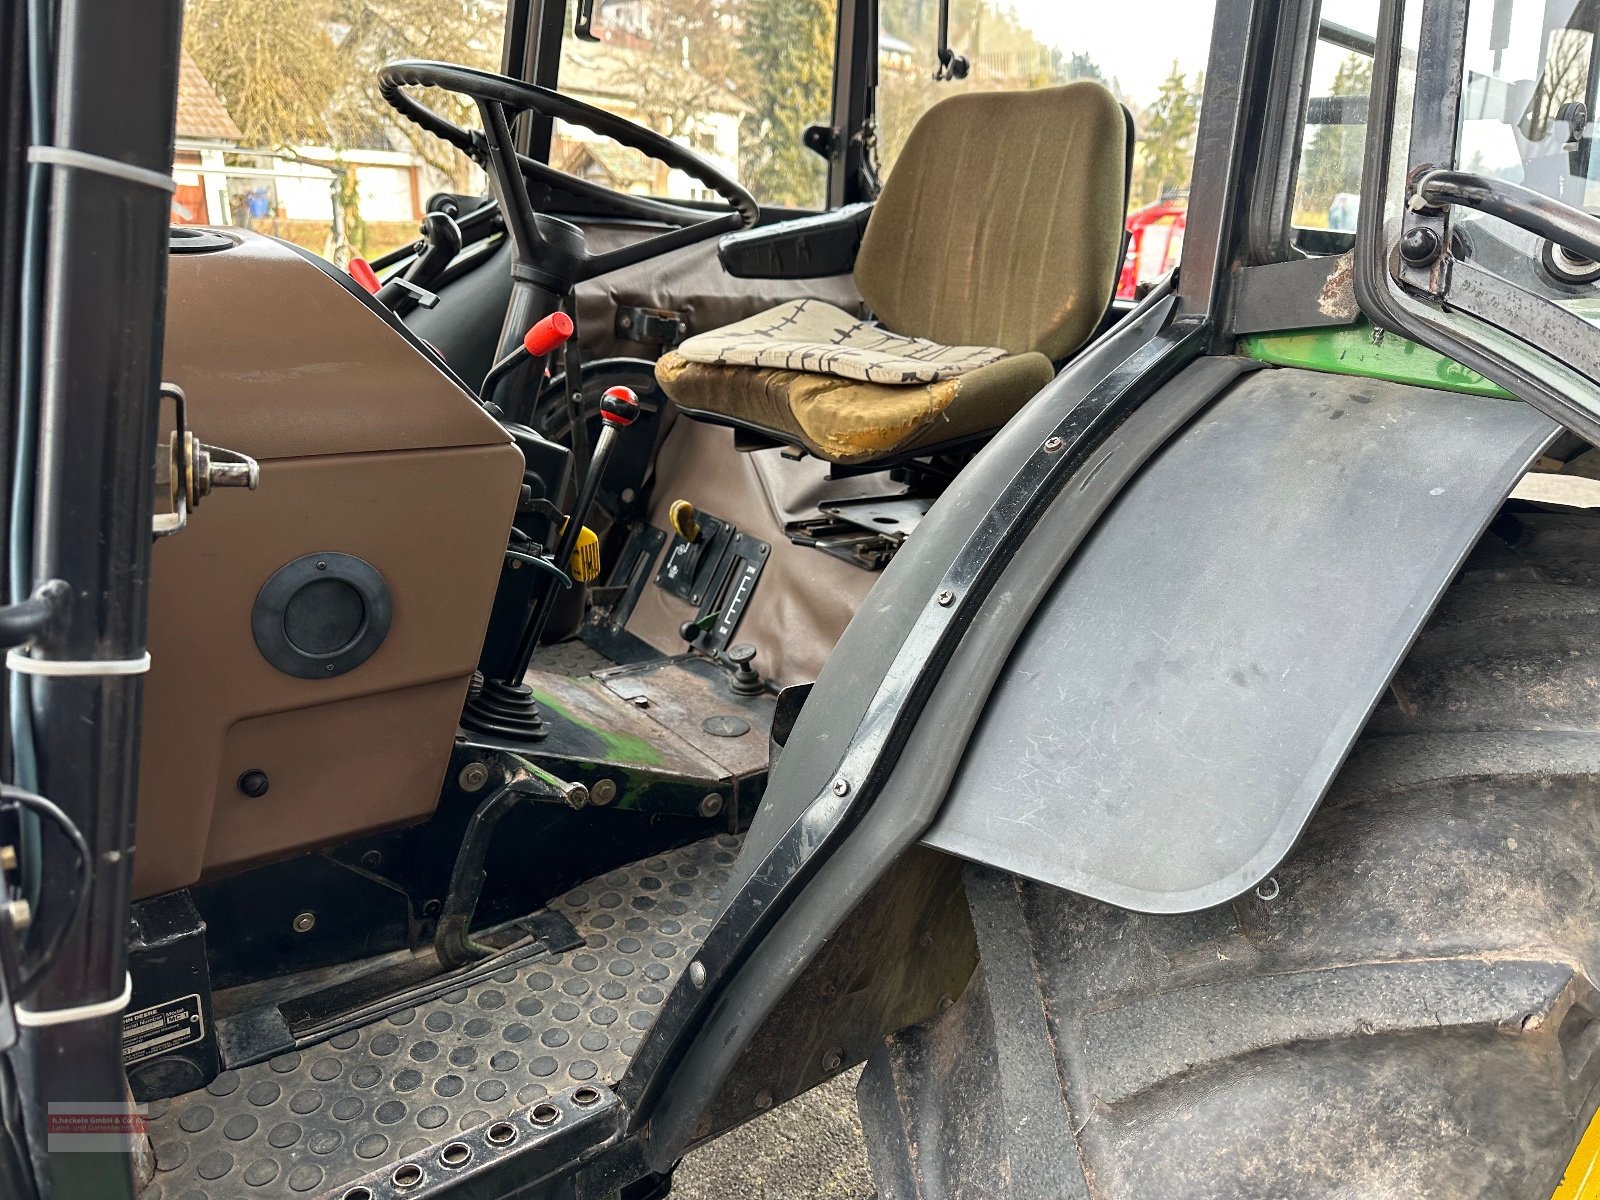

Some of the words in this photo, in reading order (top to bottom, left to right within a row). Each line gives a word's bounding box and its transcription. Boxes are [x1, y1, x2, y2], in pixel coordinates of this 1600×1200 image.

[134, 1009, 158, 1020] DEERE
[165, 1007, 185, 1017] Model
[139, 1014, 163, 1026] Number
